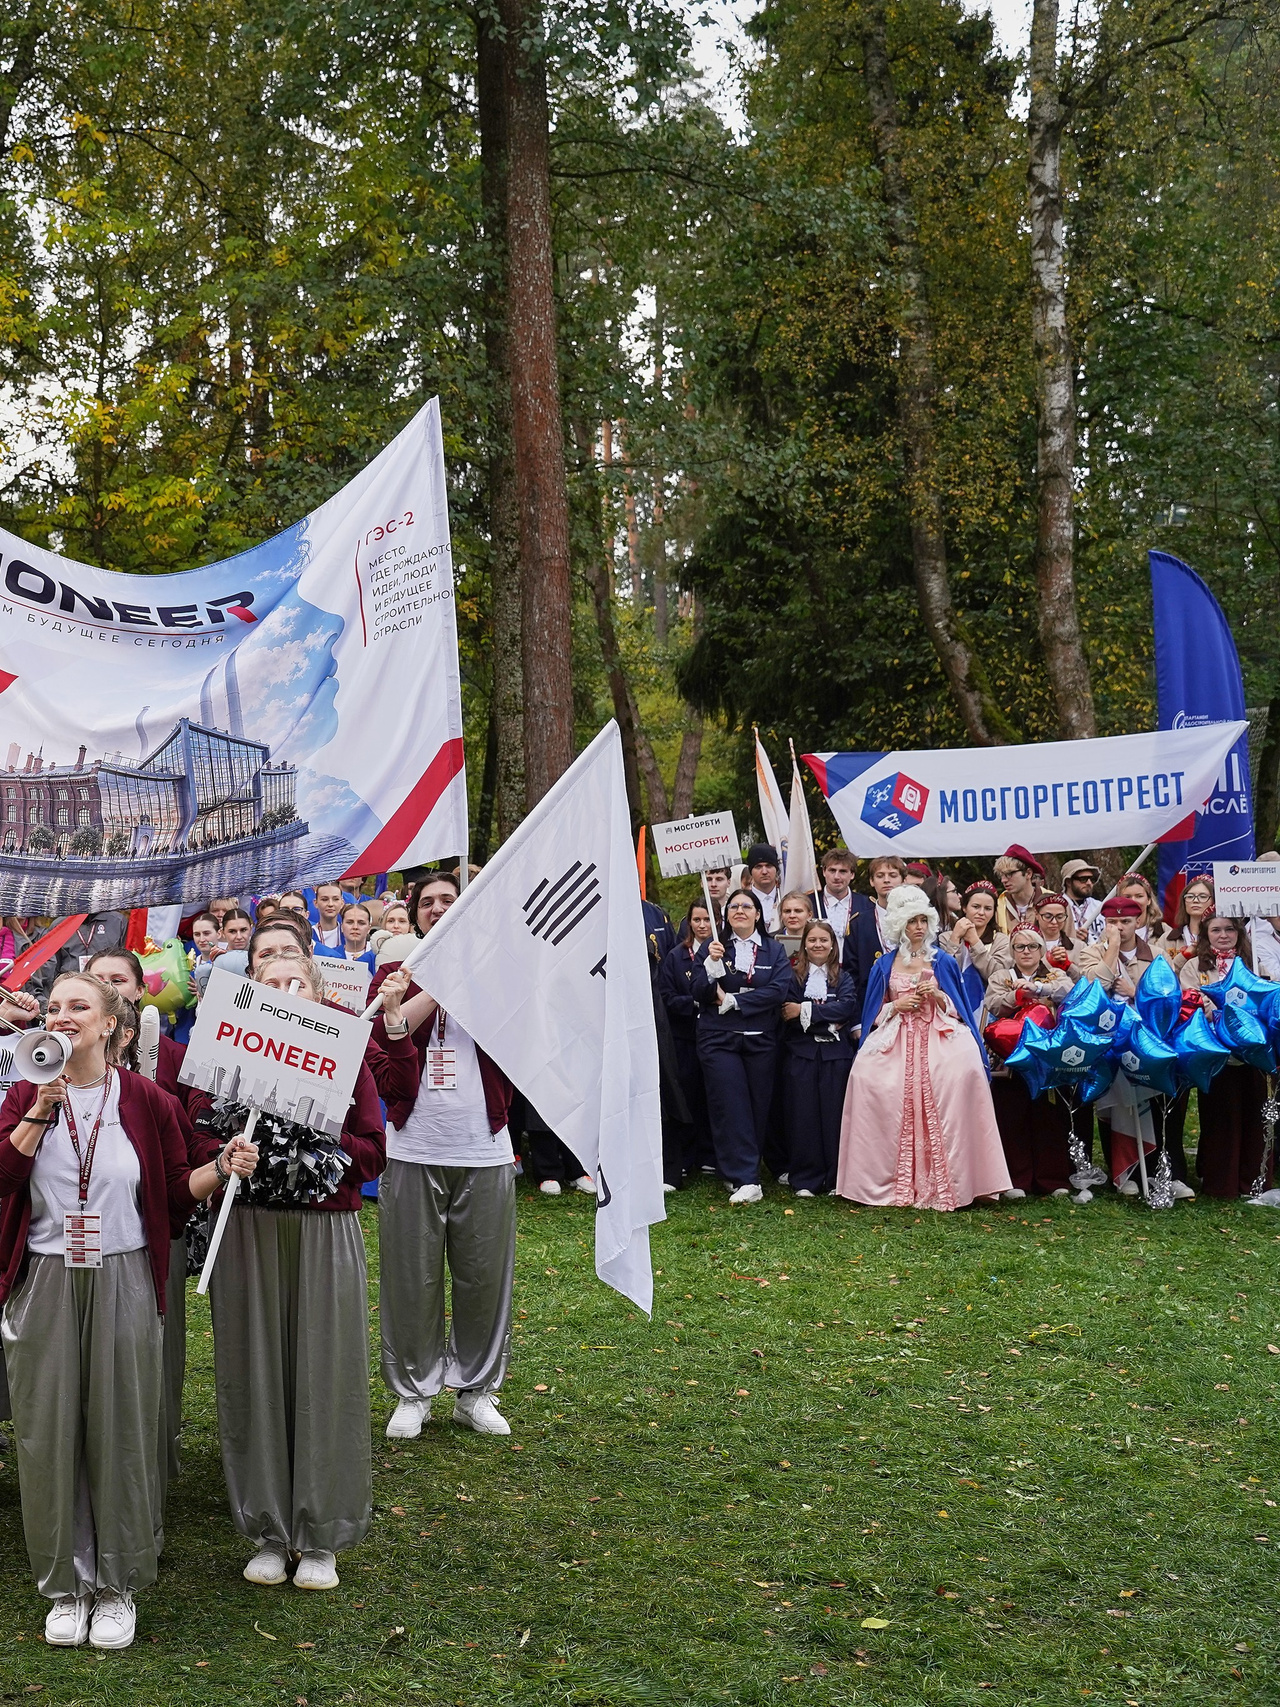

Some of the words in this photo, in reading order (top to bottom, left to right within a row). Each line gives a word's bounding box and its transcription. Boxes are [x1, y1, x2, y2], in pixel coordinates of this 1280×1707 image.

[365, 511, 415, 545] ГЭС-2
[368, 545, 407, 570] МЕСТО,
[370, 567, 391, 583] ГДЕ
[393, 542, 451, 573] РОЖДАЮТС
[372, 579, 401, 597] ИДЕИ,
[402, 562, 437, 583] ЛЮДИ
[374, 602, 382, 612] И
[383, 580, 433, 608] БУДУЩЕЕ
[27, 613, 120, 643] БУДУЩЕЕ
[134, 635, 224, 649] СЕГОДНЯ
[373, 615, 423, 641] ОТРАСЛИ
[939, 771, 1185, 824] МОСГОРГЕОТРЕСТ
[674, 818, 721, 832] МОСГОРБТИ
[664, 835, 729, 854] МОСГОРБТИ
[320, 961, 355, 971] МонАрх
[325, 981, 363, 992] Х-ПРОЕКТ
[260, 1002, 340, 1039] PIONEER
[216, 1021, 337, 1080] PIONEER
[89, 1128, 98, 1148] ГОРОДА
